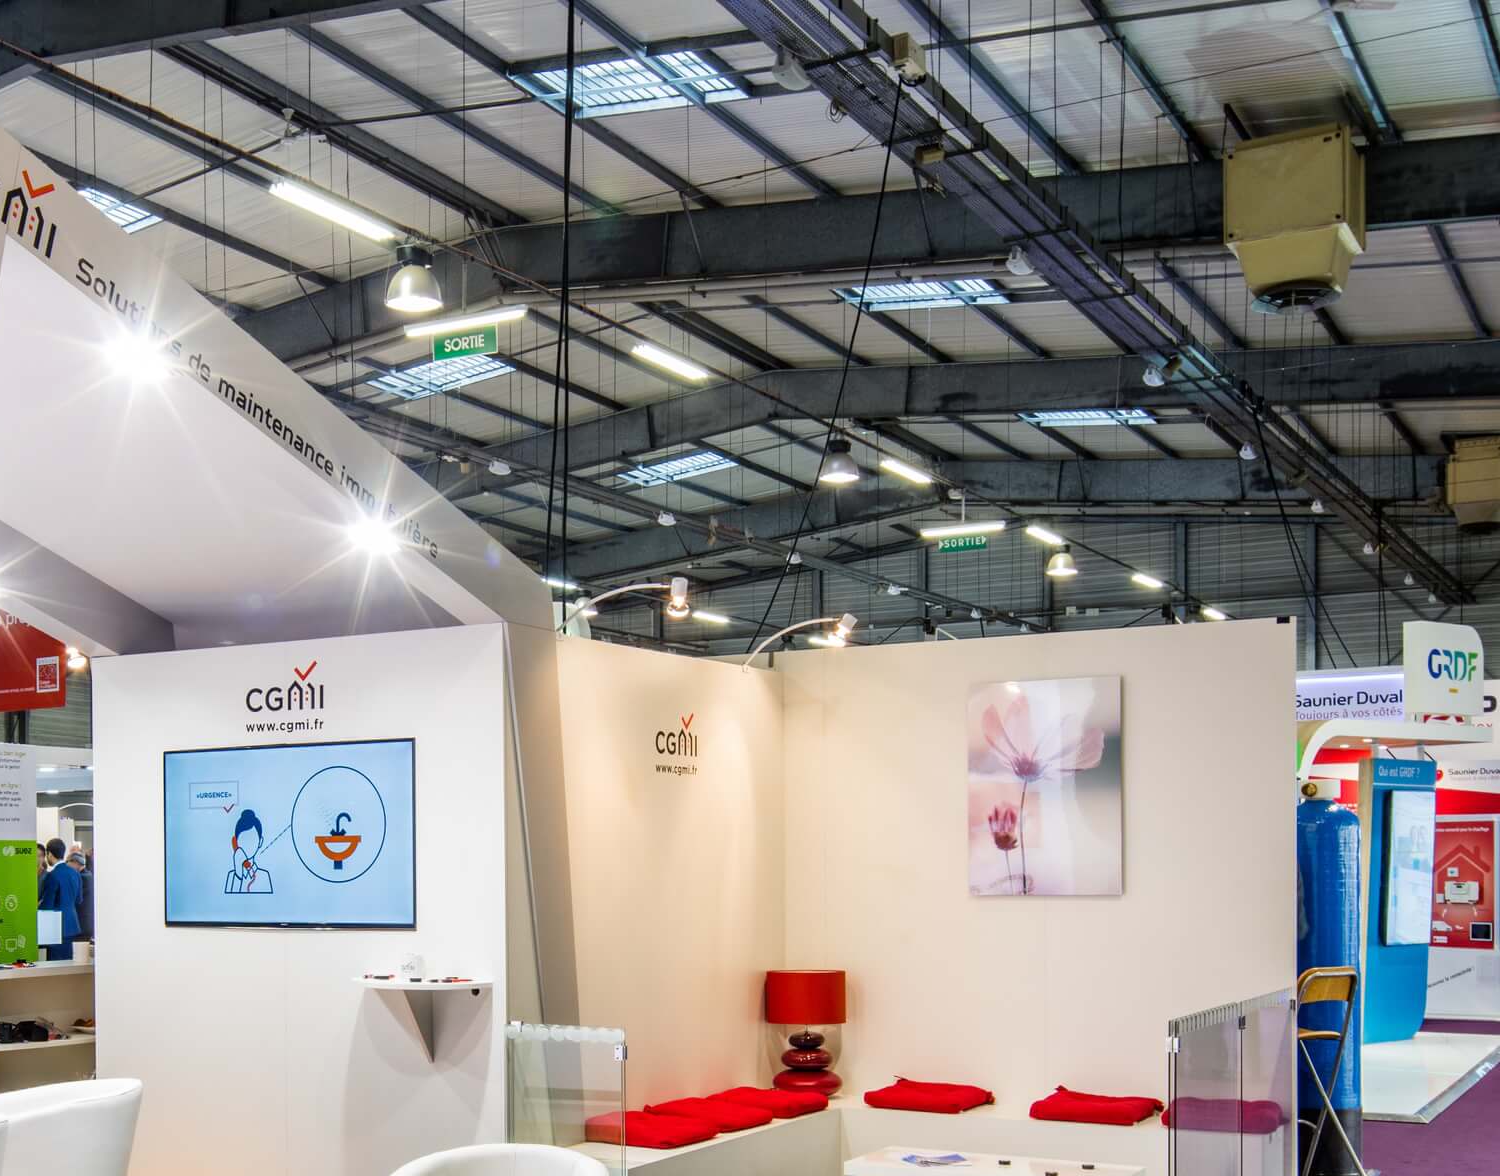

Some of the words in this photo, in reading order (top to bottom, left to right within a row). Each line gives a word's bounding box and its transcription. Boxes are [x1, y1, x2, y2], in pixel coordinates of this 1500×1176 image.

[444, 334, 485, 353] SORTIE
[189, 354, 211, 382] de
[218, 377, 334, 477] maintenance
[944, 536, 981, 549] SORTIE
[1428, 648, 1479, 683] GRDF
[246, 680, 324, 712] CGMI
[1356, 689, 1403, 706] Duval
[1343, 708, 1349, 719] à
[1373, 706, 1403, 717] côtés
[246, 718, 324, 733] www.cgmi.fr
[655, 728, 698, 757] CGMI
[655, 764, 698, 776] www.cgmi.fr
[1378, 765, 1388, 777] Qui
[1389, 767, 1399, 777] est
[1399, 766, 1414, 778] GRDF
[1448, 767, 1478, 776] Saunier
[1480, 767, 1500, 775] Duva
